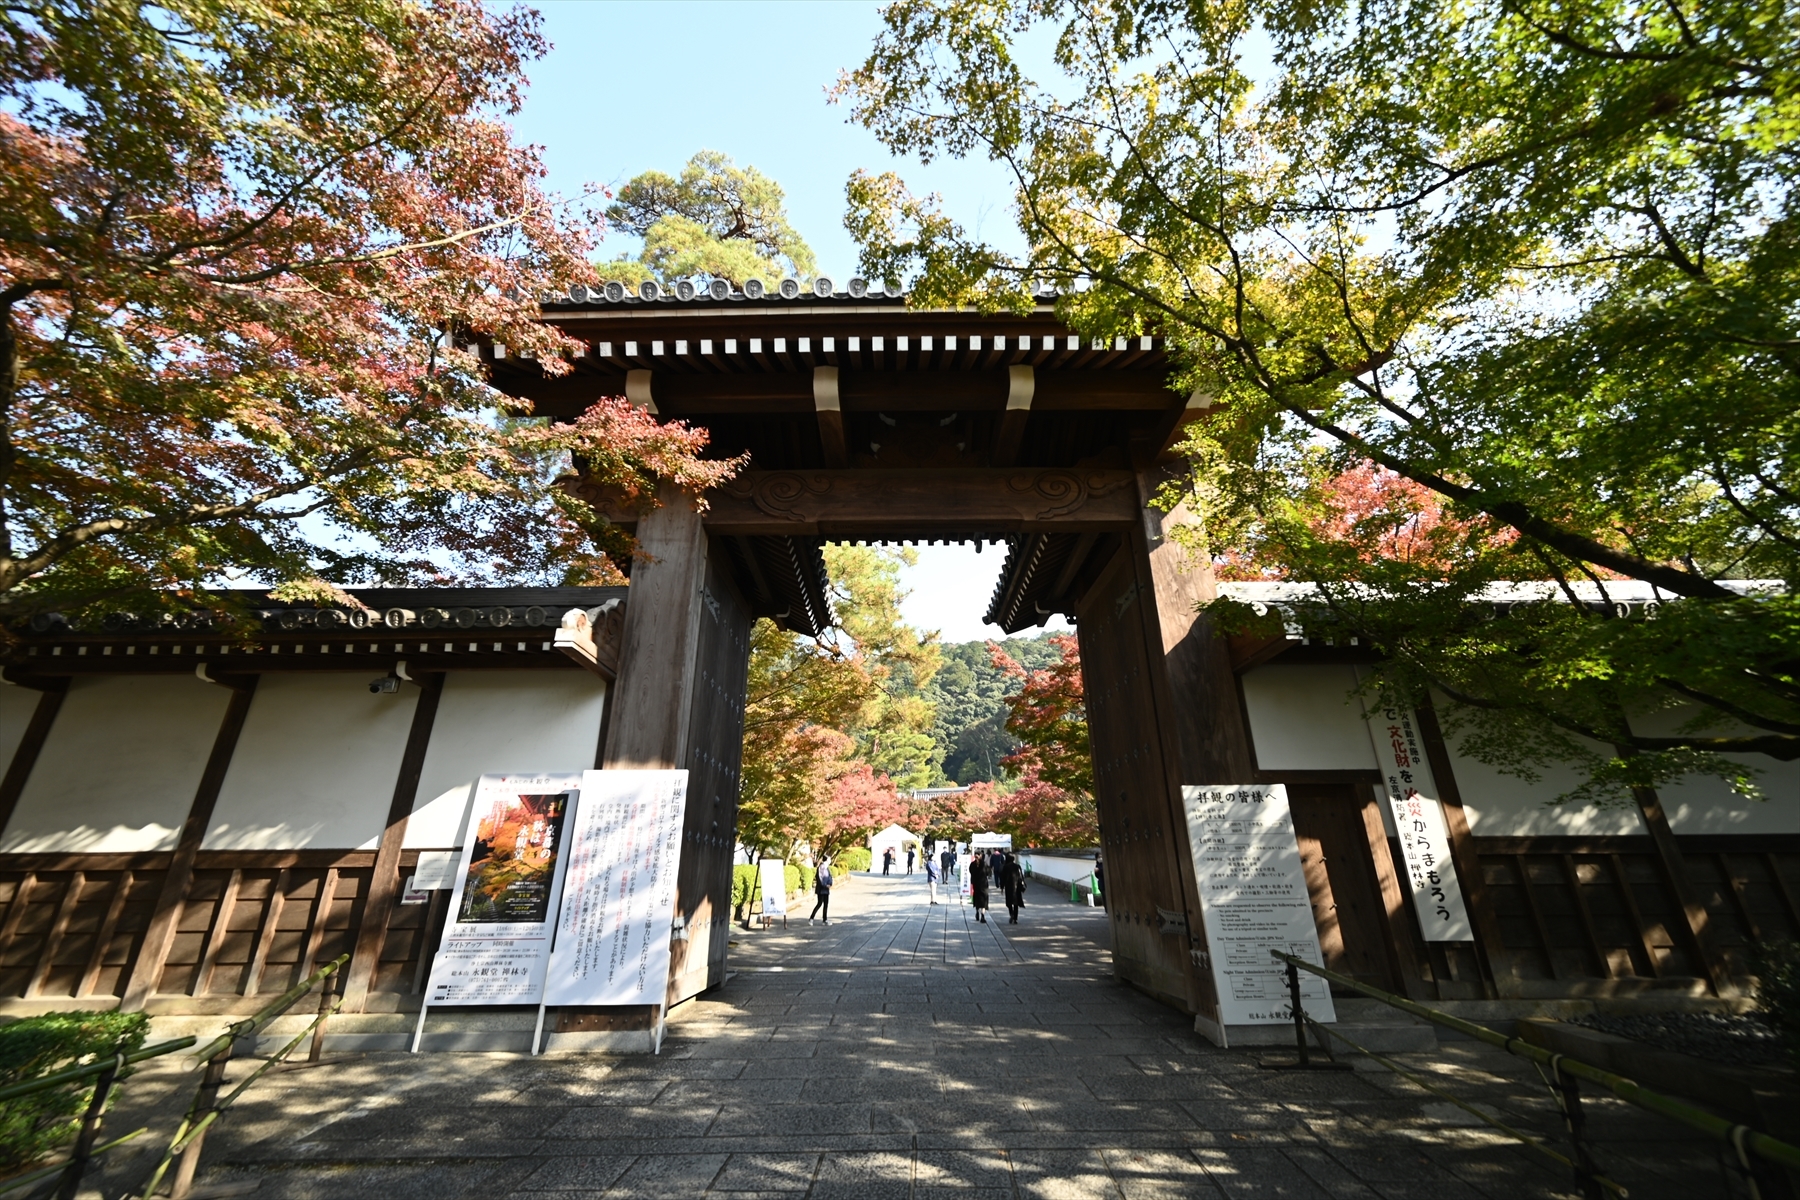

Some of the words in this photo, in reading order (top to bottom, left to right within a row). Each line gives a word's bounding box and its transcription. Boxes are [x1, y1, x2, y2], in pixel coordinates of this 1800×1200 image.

[1197, 790, 1277, 803] 拝観の皆様へ
[1372, 682, 1450, 921] で文化財を火災からまもろう
[513, 824, 529, 860] 永観堂
[530, 820, 546, 844] 秋は
[540, 824, 556, 859] 京都の
[447, 941, 483, 949] ライトアップ
[472, 967, 498, 977] 永観堂
[501, 967, 529, 976] 禅林寺
